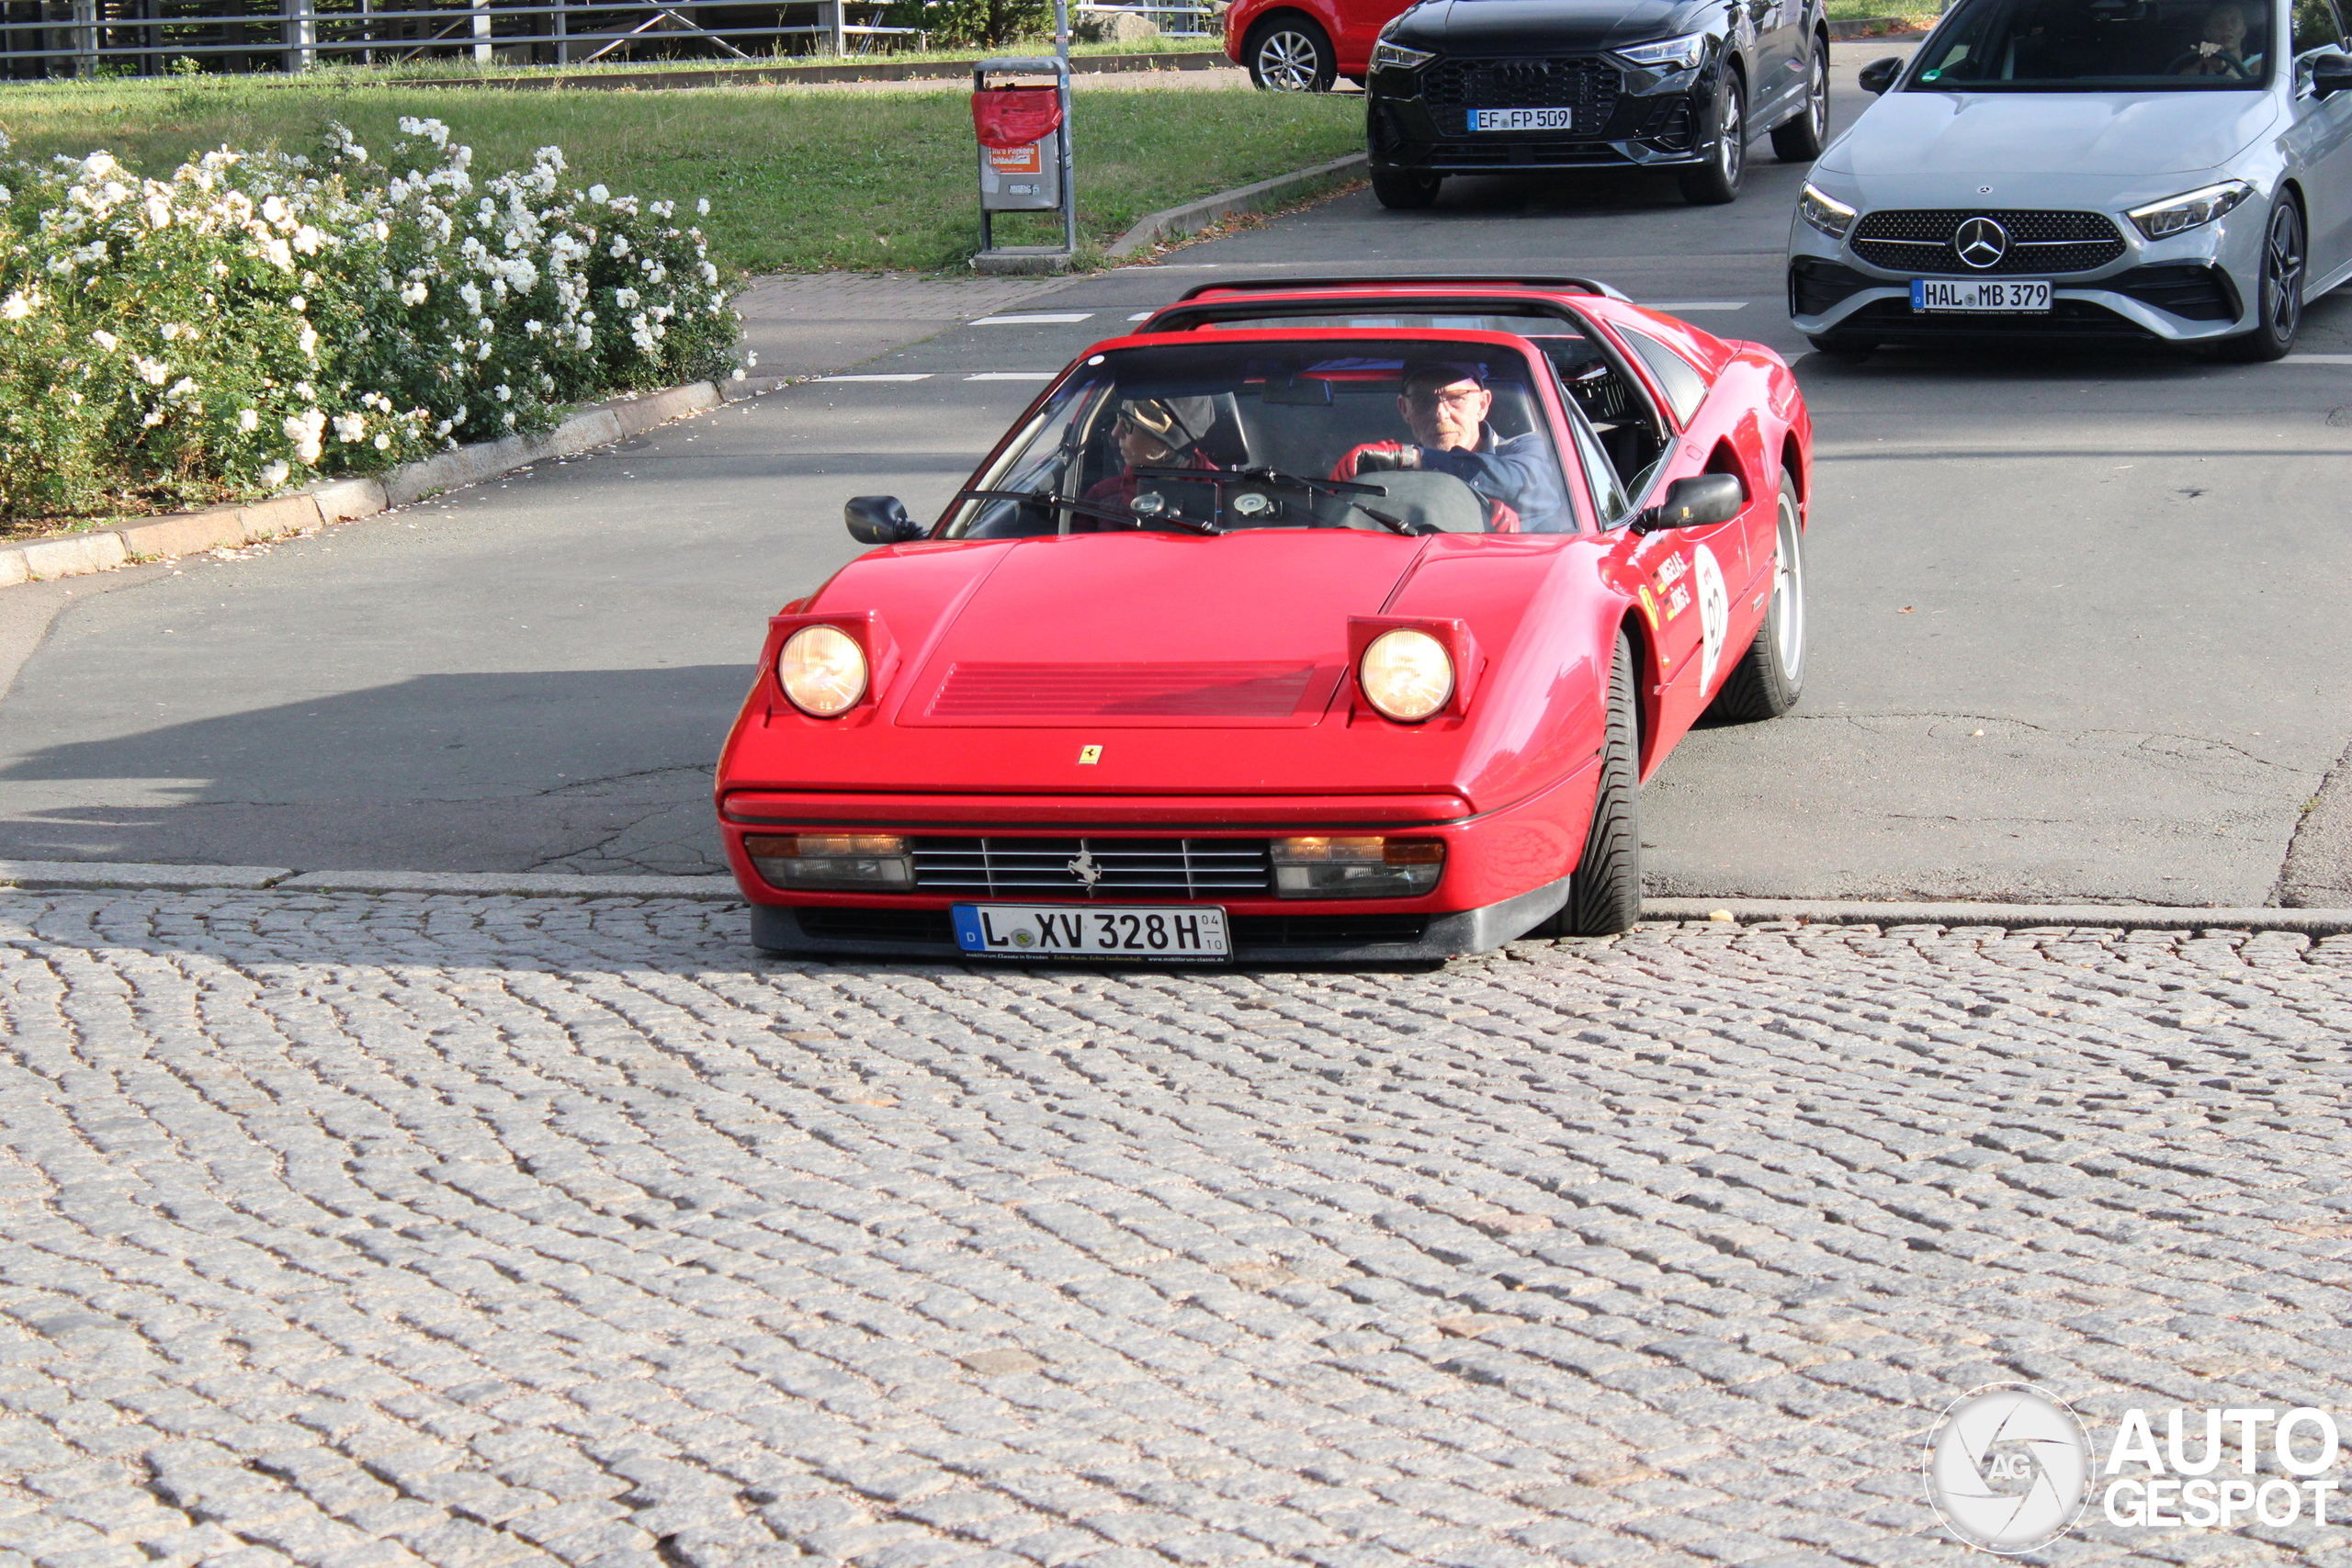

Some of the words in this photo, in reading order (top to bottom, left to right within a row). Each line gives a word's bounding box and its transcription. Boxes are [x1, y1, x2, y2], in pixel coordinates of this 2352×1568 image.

[1478, 111, 1499, 128] EF
[1511, 111, 1532, 128] FP
[1536, 110, 1568, 127] 509
[1007, 147, 1035, 155] Papiere
[1925, 284, 1962, 305] HAL
[1978, 285, 2004, 306] MB
[2009, 285, 2048, 306] 379
[1708, 588, 1721, 668] 92
[1201, 915, 1219, 926] 04
[967, 932, 976, 942] D
[982, 912, 1009, 946] L
[1035, 913, 1082, 948] XV
[1206, 939, 1223, 951] 10
